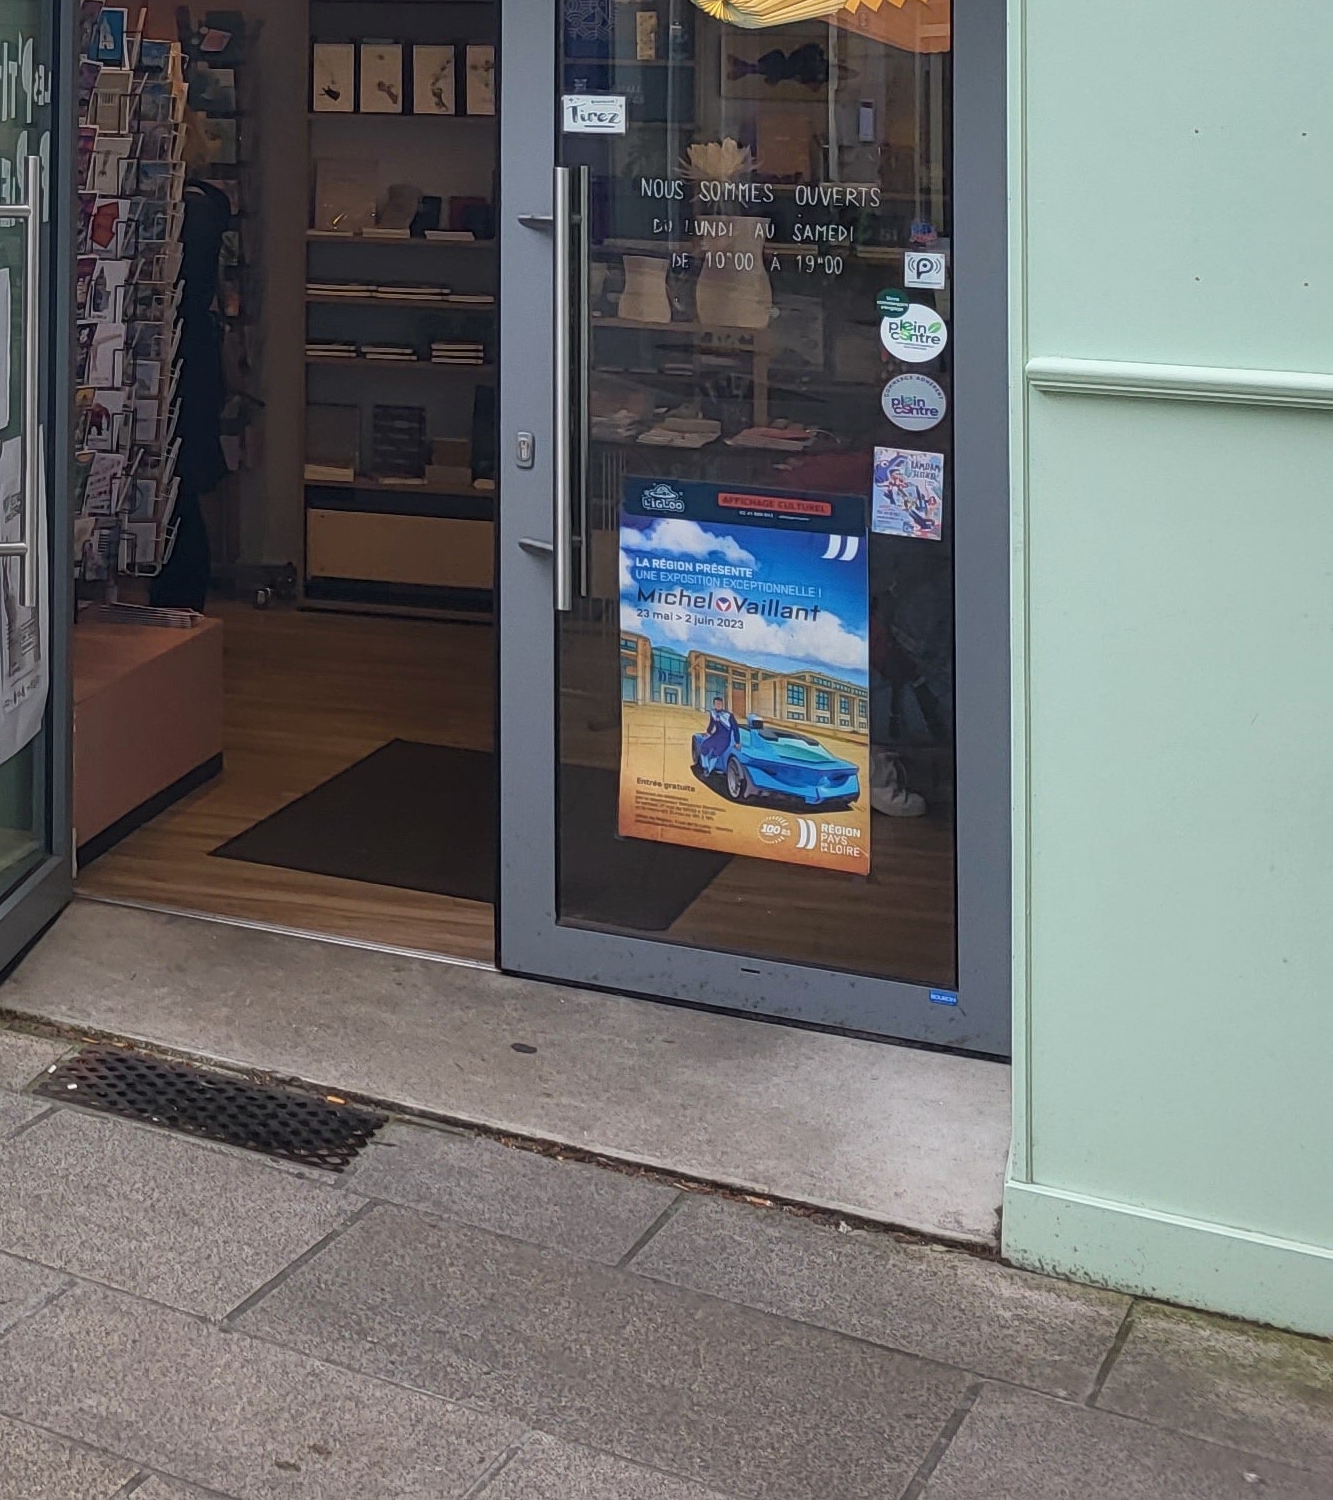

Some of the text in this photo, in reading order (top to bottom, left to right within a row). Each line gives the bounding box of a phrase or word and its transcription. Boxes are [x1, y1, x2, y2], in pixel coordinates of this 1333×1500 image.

[566, 103, 621, 124] Tirez
[641, 178, 881, 207] NOUS SOMMES OUVERTS
[755, 224, 775, 239] AU
[793, 224, 854, 242] SAMEDI
[889, 320, 926, 333] plein
[891, 332, 941, 344] centre
[892, 395, 925, 408] plein
[894, 407, 939, 416] centre
[636, 557, 753, 578] LA RÉGION PRÉSENTE
[636, 570, 657, 581] UNE
[660, 572, 720, 587] EXPOSITION
[723, 578, 815, 597] EXCEPTIONNELLE
[637, 586, 820, 622] Michel Vaillant
[637, 608, 650, 619] 23
[652, 611, 673, 621] mai
[685, 614, 692, 624] 2
[694, 614, 715, 627] juin
[717, 617, 744, 629] 2023
[821, 823, 861, 838] RÉGION
[821, 833, 848, 846] PAYS
[830, 844, 861, 858] LOIRE
